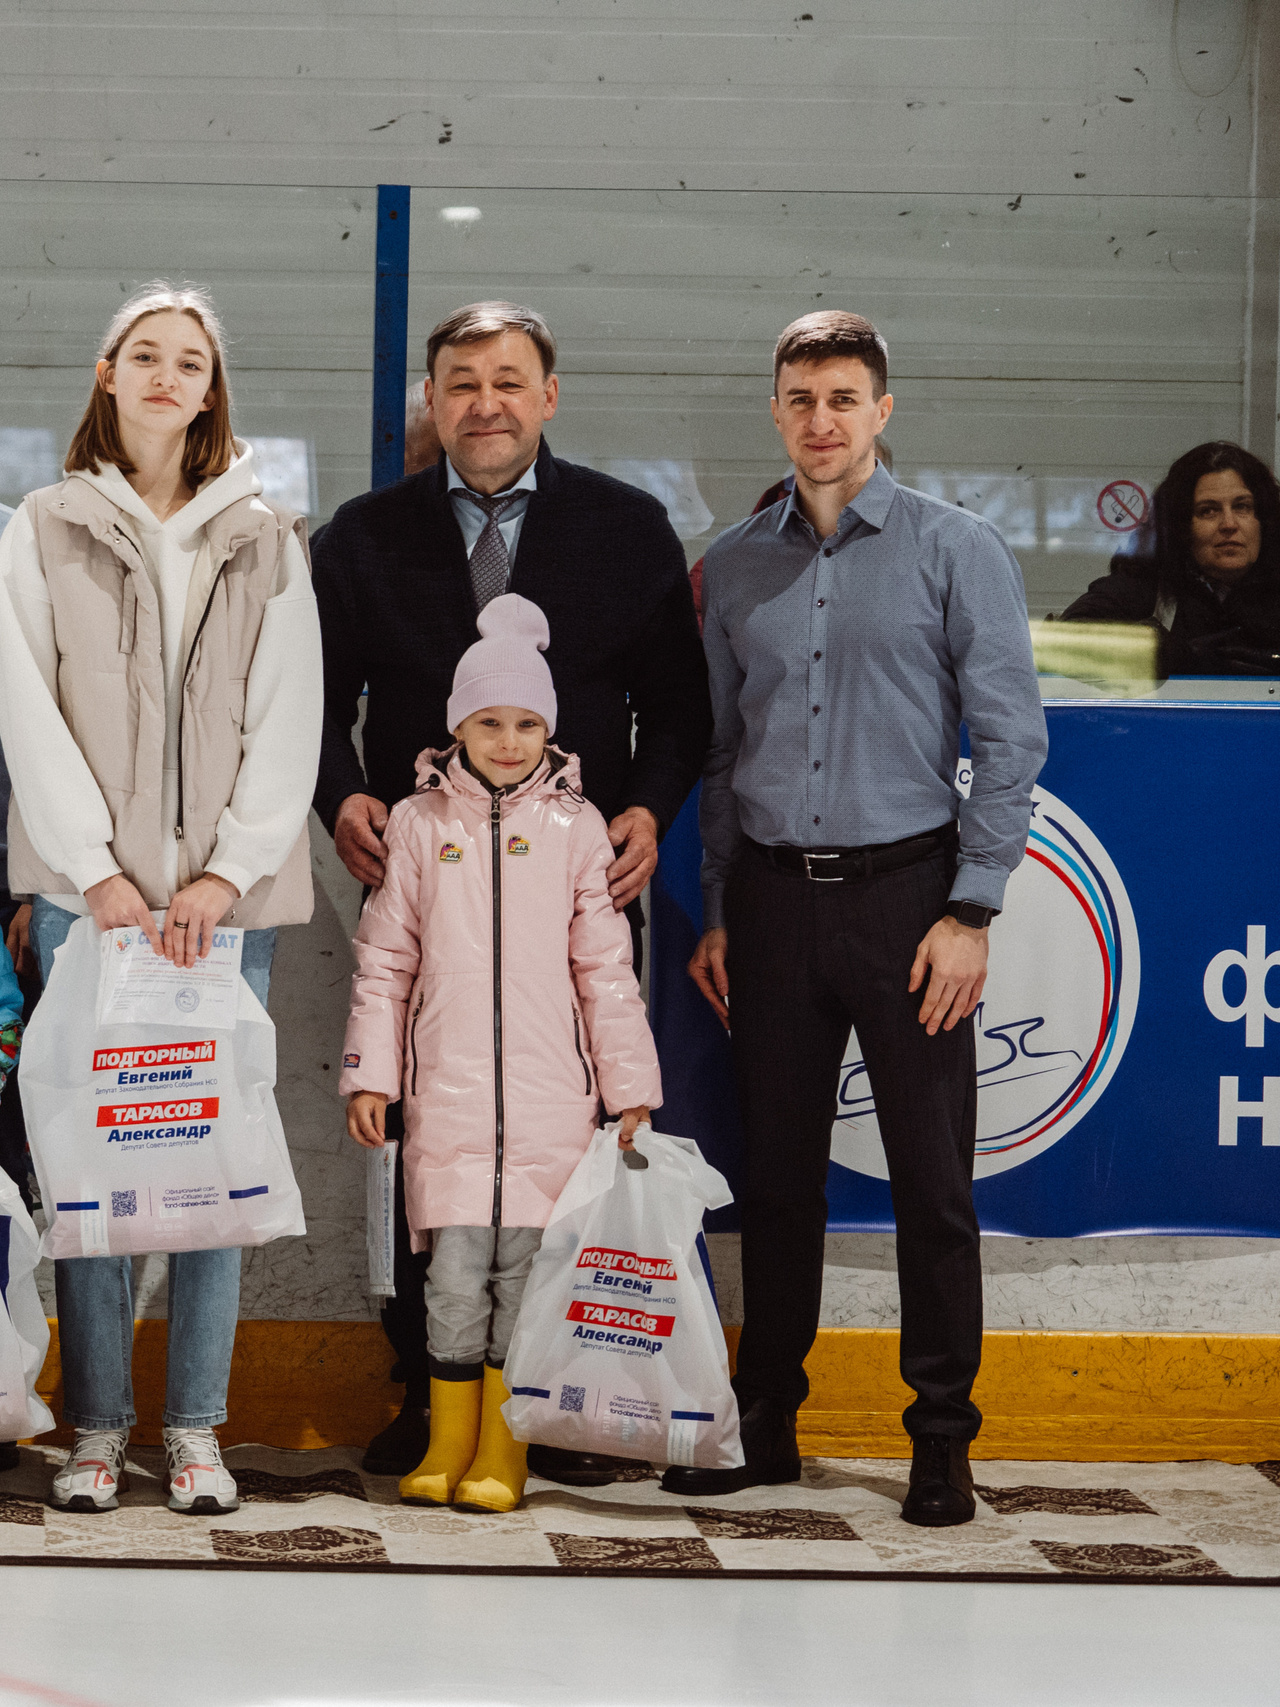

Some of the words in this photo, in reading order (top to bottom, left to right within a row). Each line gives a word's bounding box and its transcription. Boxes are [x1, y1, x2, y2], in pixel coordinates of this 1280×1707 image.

[96, 1042, 213, 1069] ПОДГОРНЫЙ
[118, 1066, 193, 1085] Евгений
[95, 1087, 118, 1096] Депутат
[119, 1083, 174, 1093] Законодательного
[174, 1080, 204, 1088] Собрания
[205, 1078, 218, 1086] НСО
[112, 1102, 203, 1122] ТАРАСОВ
[107, 1125, 212, 1142] Александр
[121, 1144, 144, 1152] Депутат
[146, 1141, 167, 1149] Совета
[168, 1140, 199, 1148] депутатов
[593, 1270, 653, 1294] Евгенй
